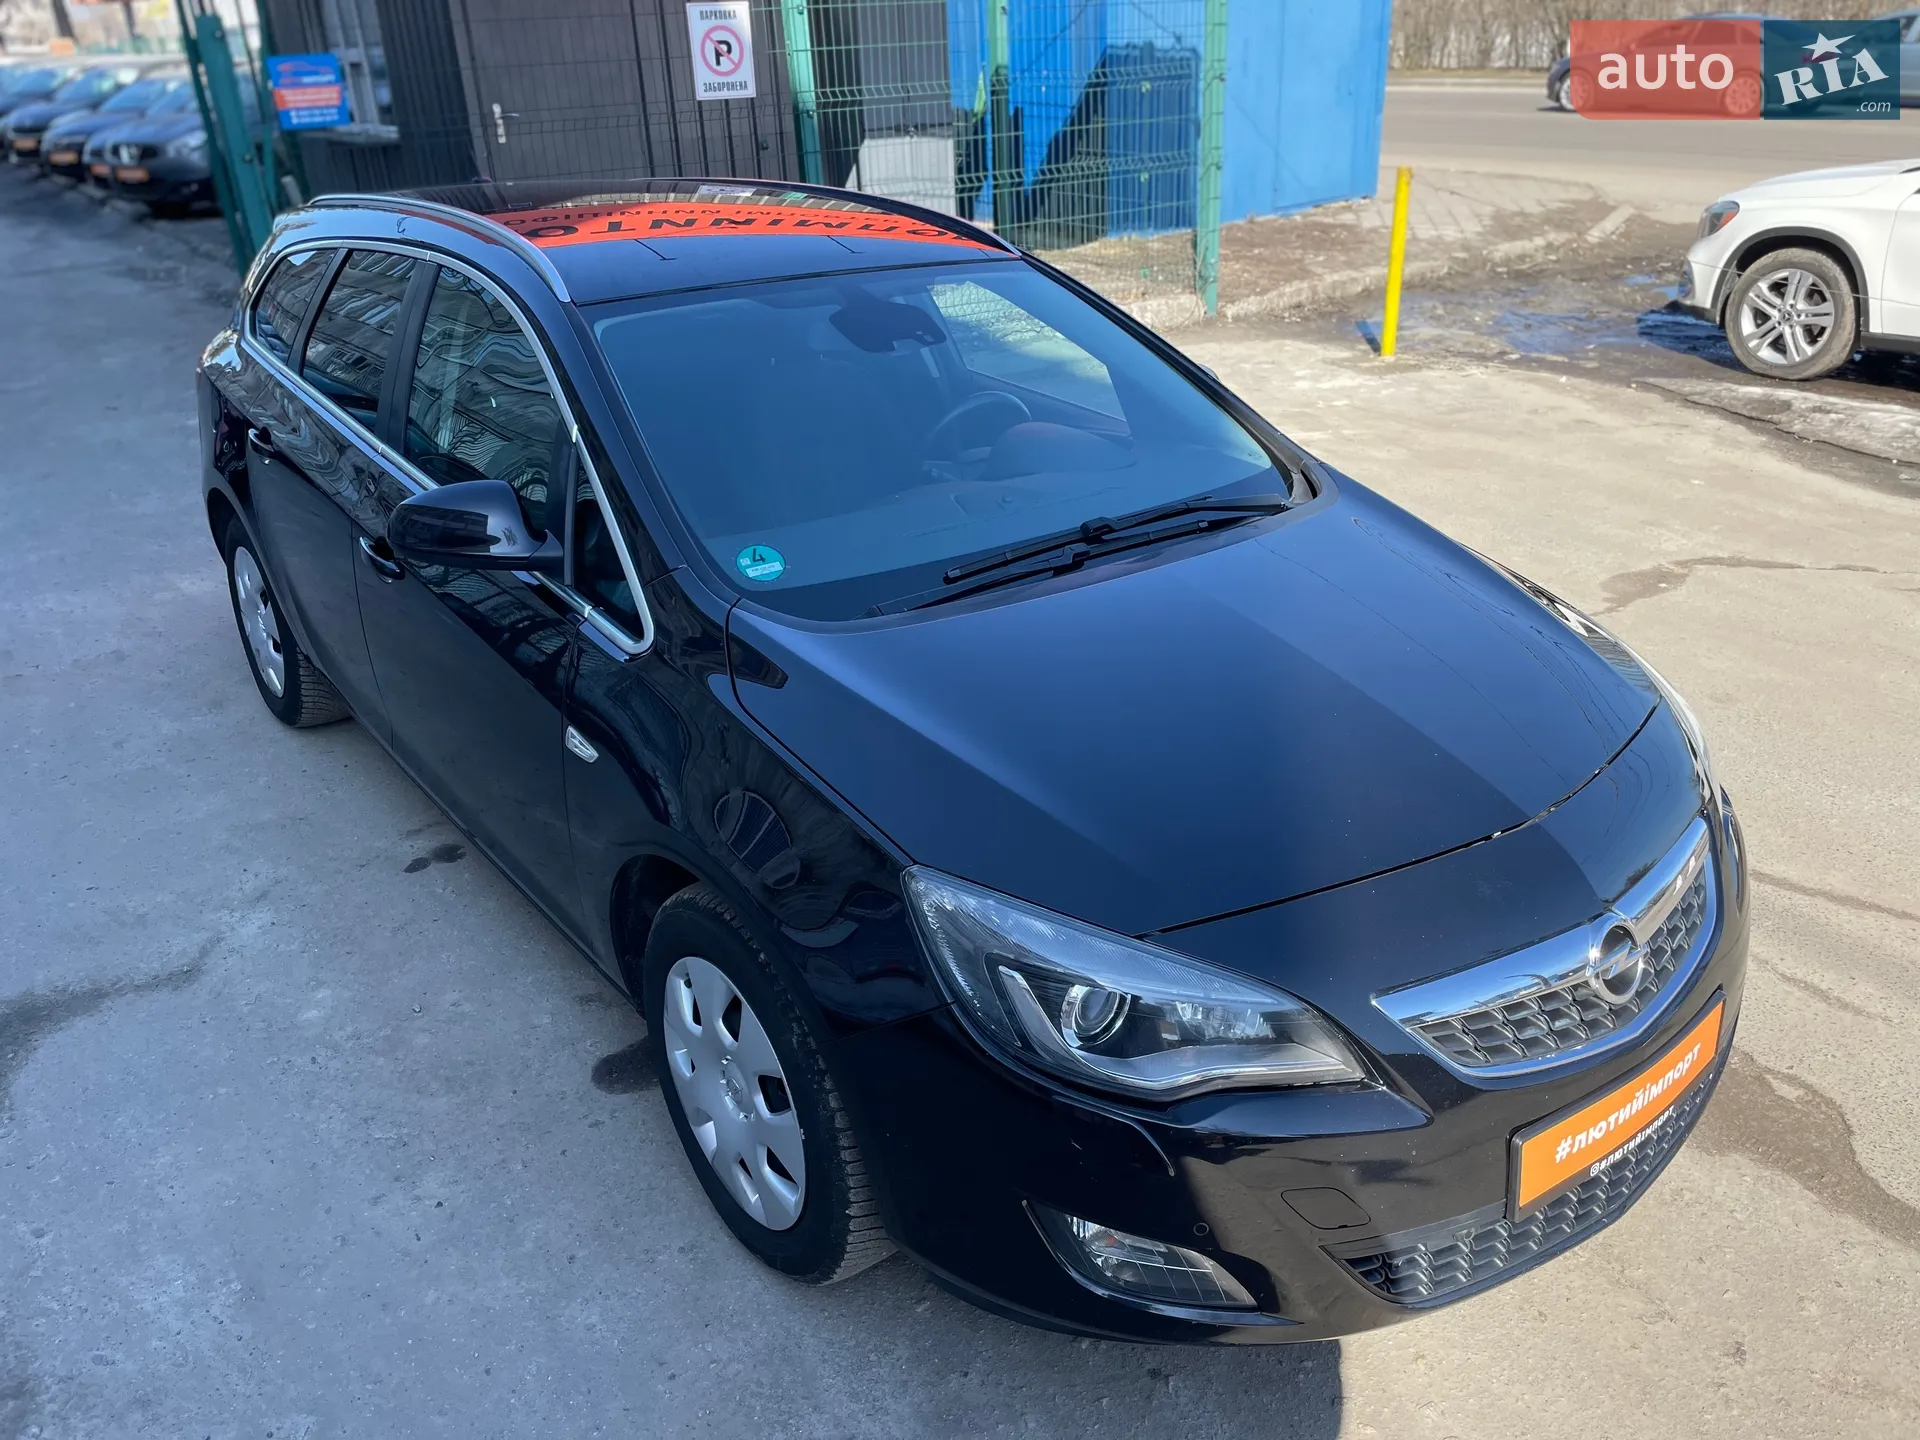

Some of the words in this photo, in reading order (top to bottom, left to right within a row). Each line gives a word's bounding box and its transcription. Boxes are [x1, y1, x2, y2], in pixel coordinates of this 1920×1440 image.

[699, 10, 737, 20] ПАРКОВКА
[703, 81, 748, 93] ЗАБОРОНЕНА
[752, 548, 766, 563] 4
